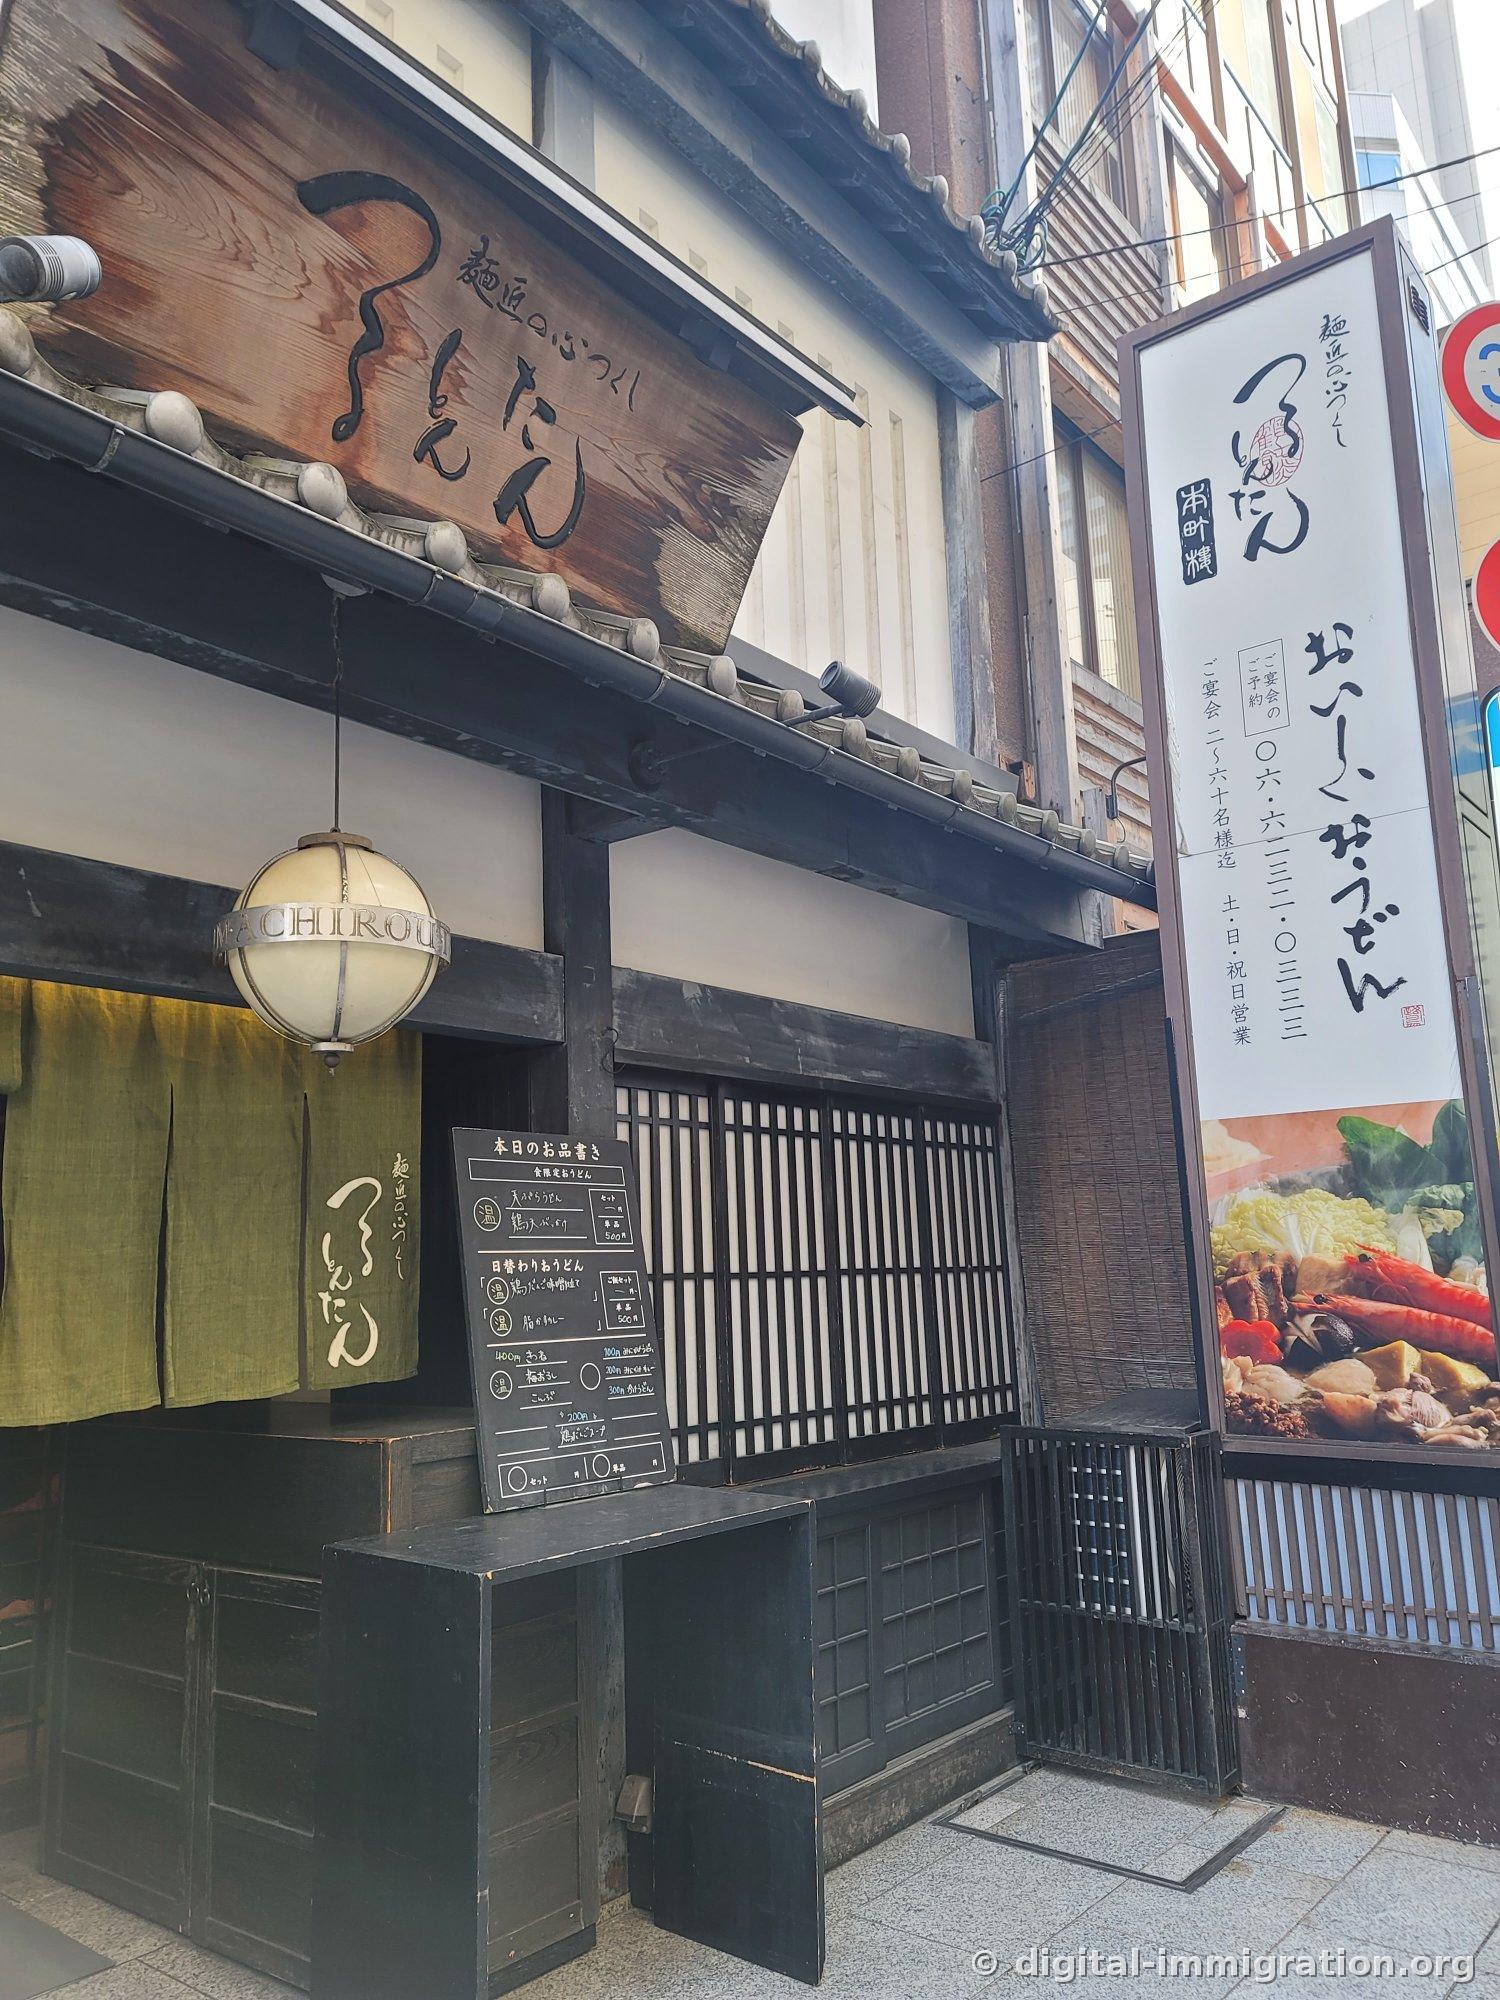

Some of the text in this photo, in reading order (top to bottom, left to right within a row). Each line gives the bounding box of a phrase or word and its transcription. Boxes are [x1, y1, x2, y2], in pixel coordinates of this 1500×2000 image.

[1247, 657, 1264, 708] ご予約
[1263, 652, 1281, 719] ご宴会の
[493, 1136, 600, 1161] 本日のお品書き
[492, 1258, 584, 1275] 日替わりおうどん
